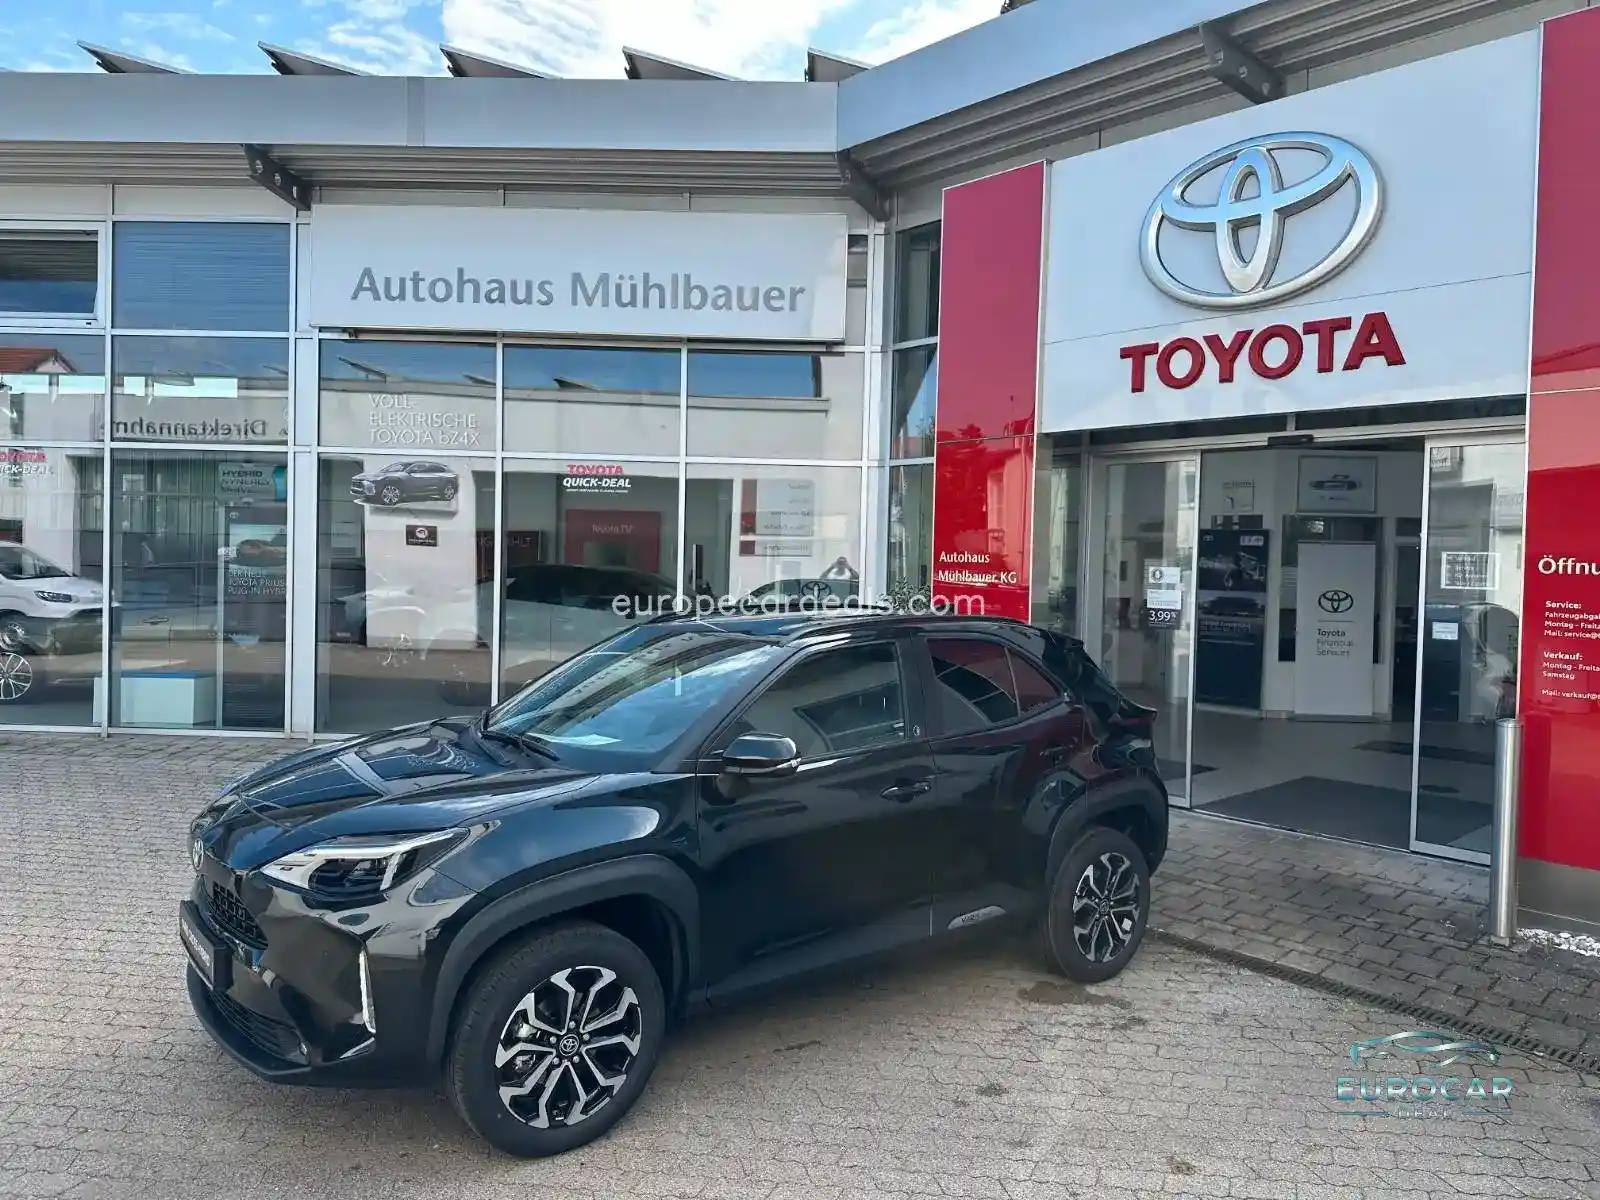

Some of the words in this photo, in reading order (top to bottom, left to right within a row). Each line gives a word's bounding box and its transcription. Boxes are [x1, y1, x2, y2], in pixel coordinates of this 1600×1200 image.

[351, 267, 554, 306] Autohaus
[570, 271, 806, 313] Mühlbauer
[1120, 311, 1407, 393] TOYOTA
[368, 411, 479, 428] ELEKTRISCHE
[369, 428, 435, 445] TOYOTA
[439, 430, 481, 448] bZ4X
[222, 470, 263, 478] HYBRID
[566, 463, 624, 475] TOYOTA
[562, 477, 632, 489] QUICK-DEAL
[939, 551, 991, 563] Autohaus
[1538, 554, 1600, 576] Öffnu
[938, 569, 998, 582] Mühlbauer
[1000, 571, 1017, 584] KG
[228, 578, 258, 587] TOYOTA
[1545, 600, 1582, 609] Service:
[1544, 620, 1574, 630] Montag
[1317, 628, 1346, 639] Toyota
[1543, 629, 1563, 637] Mail:
[1543, 651, 1583, 661] Verkauf:
[1542, 661, 1572, 671] Montag
[1542, 670, 1575, 680] Samstag
